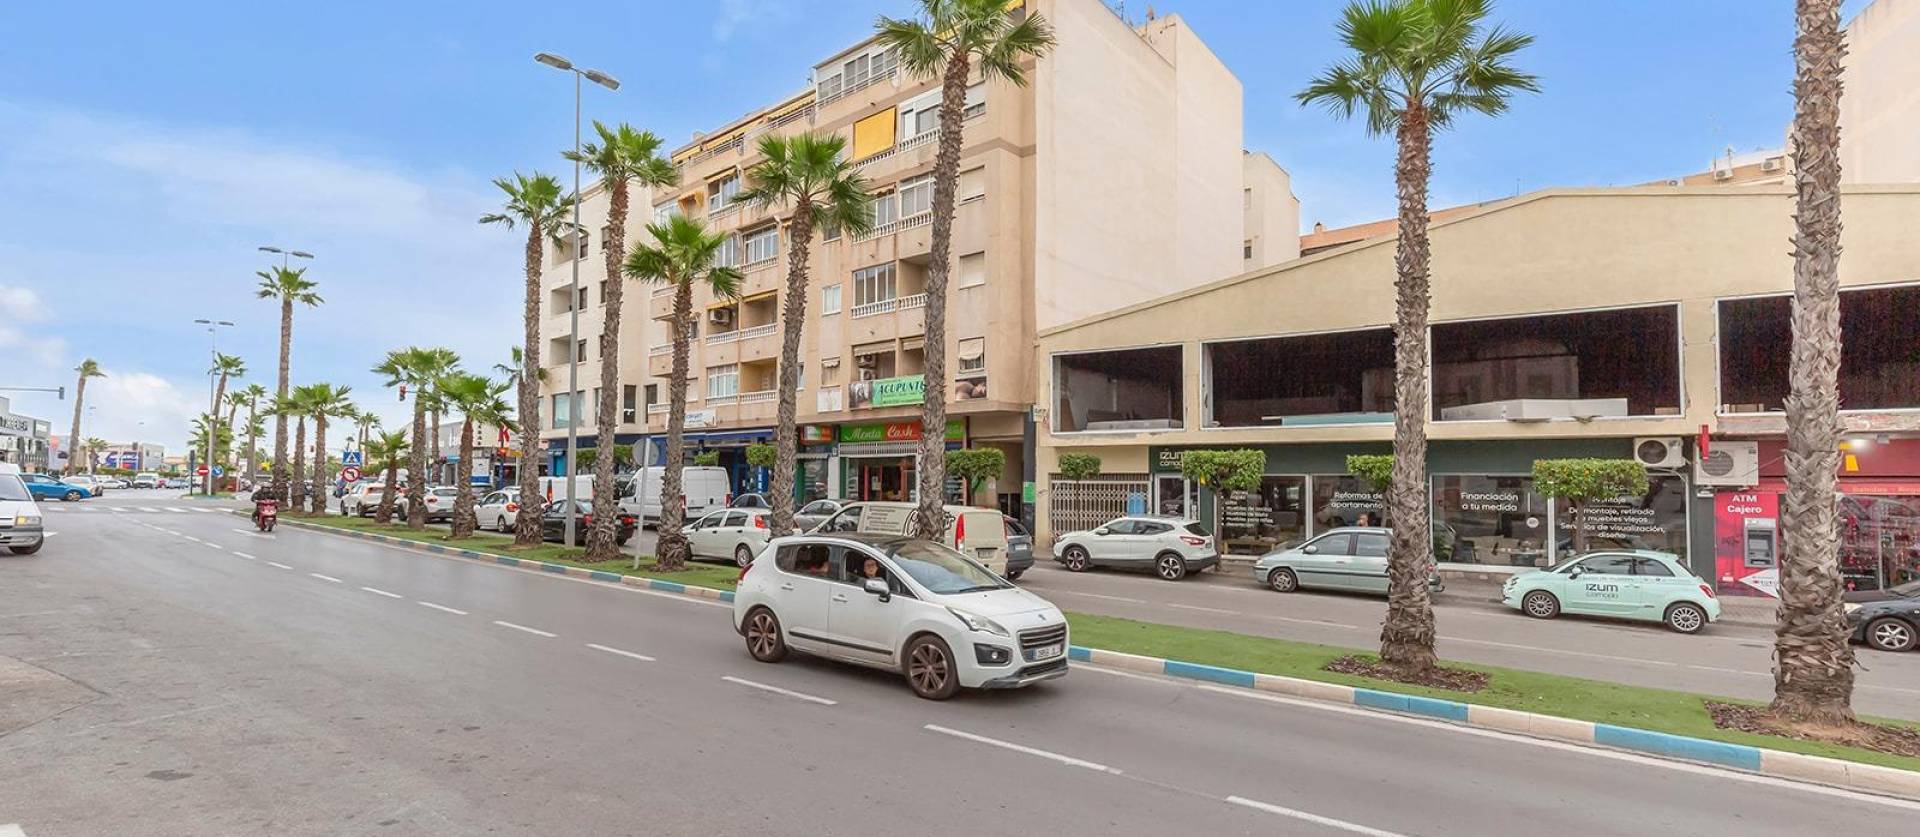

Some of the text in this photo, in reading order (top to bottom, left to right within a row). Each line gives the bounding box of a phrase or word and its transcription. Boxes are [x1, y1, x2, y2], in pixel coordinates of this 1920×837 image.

[887, 424, 914, 438] Cash
[1461, 493, 1519, 501] Financiación
[1732, 494, 1757, 502] ATM
[1470, 502, 1480, 510] tu
[1481, 503, 1518, 511] medida
[1727, 505, 1763, 514] Cajero
